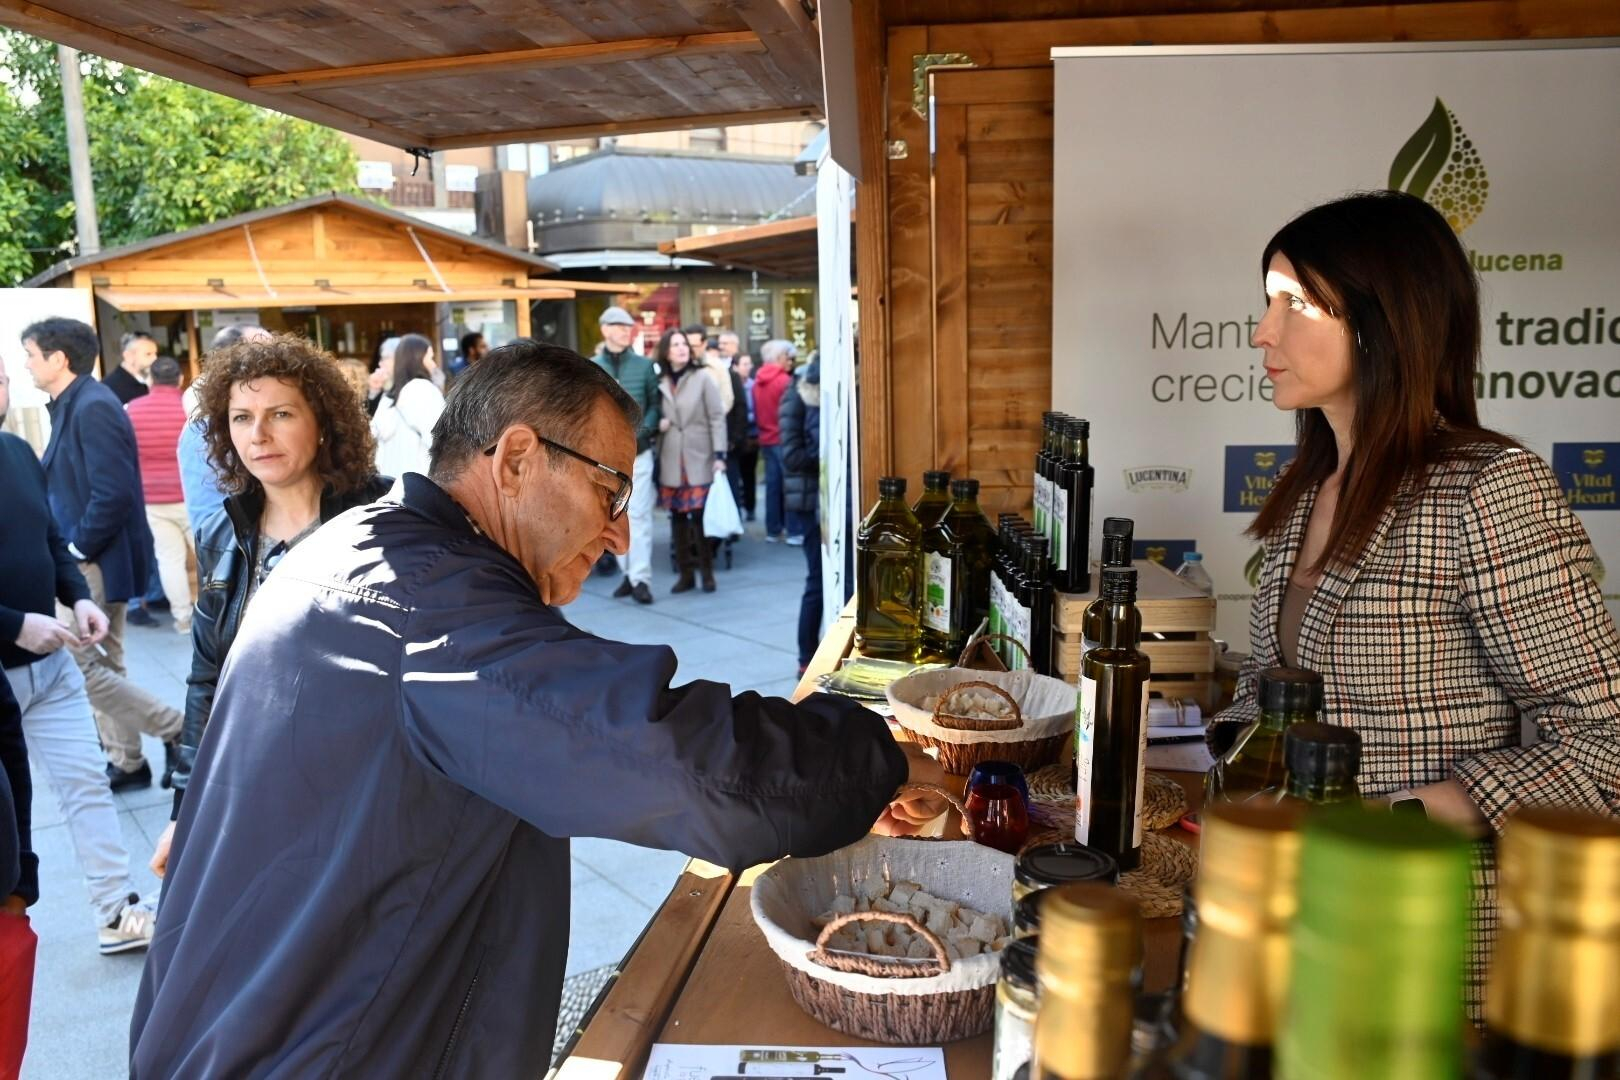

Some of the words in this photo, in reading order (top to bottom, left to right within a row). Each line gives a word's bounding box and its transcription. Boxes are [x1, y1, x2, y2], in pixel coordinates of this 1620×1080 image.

[1151, 312, 1260, 349] Mant
[1151, 364, 1273, 403] crecie
[1128, 469, 1186, 486] LUCENTINA
[1571, 473, 1613, 488] Vital
[1567, 488, 1616, 504] Heart
